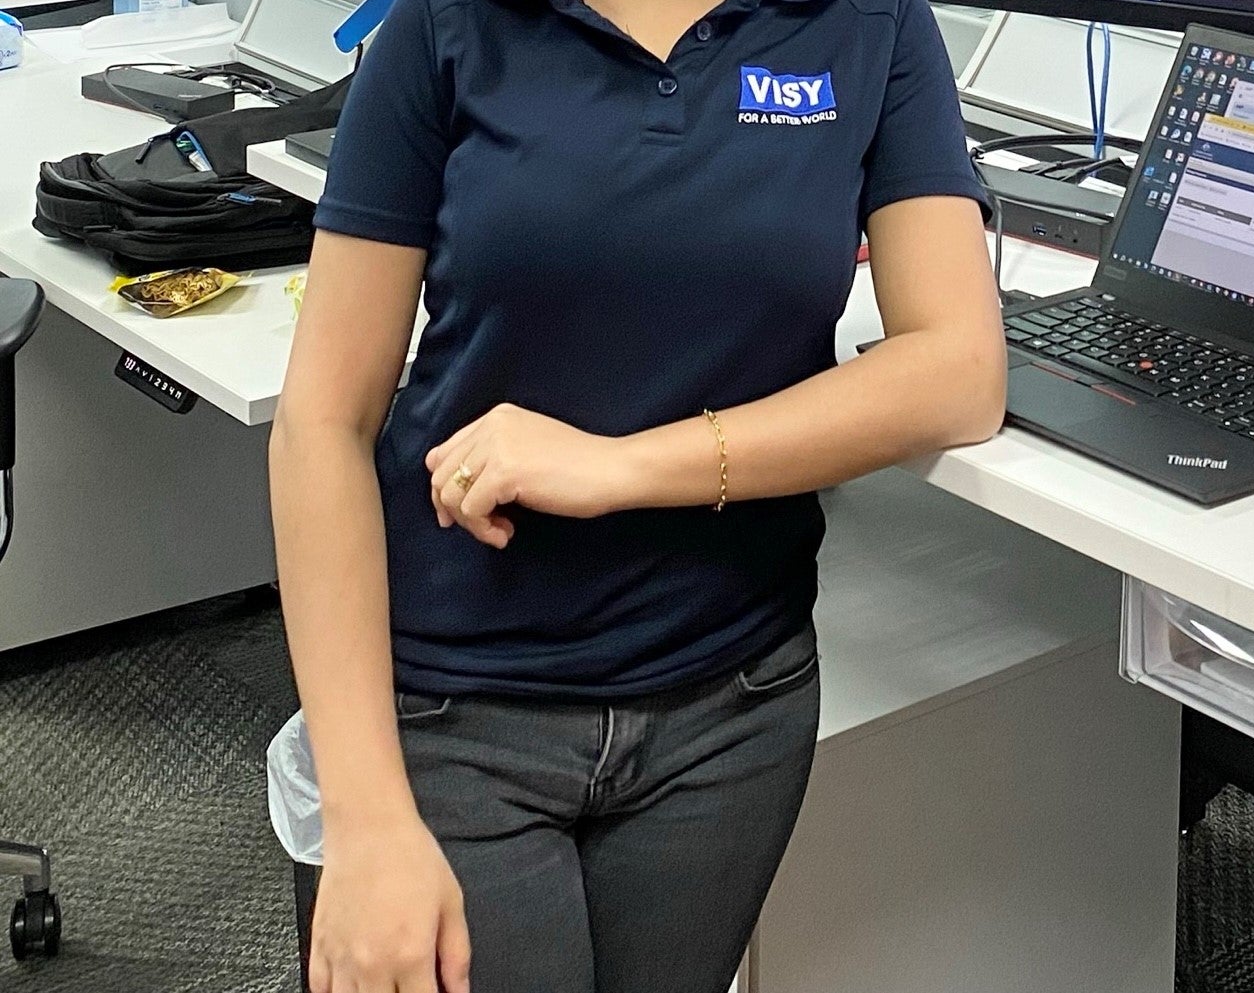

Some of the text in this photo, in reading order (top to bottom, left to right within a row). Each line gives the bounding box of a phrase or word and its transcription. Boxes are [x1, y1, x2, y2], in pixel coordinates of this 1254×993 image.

[746, 74, 823, 108] VISY
[738, 110, 836, 126] FOR A BETTER WORLD
[154, 378, 161, 387] 2
[162, 382, 168, 390] 3
[169, 386, 175, 395] 4
[1167, 454, 1228, 470] ThinkPad
